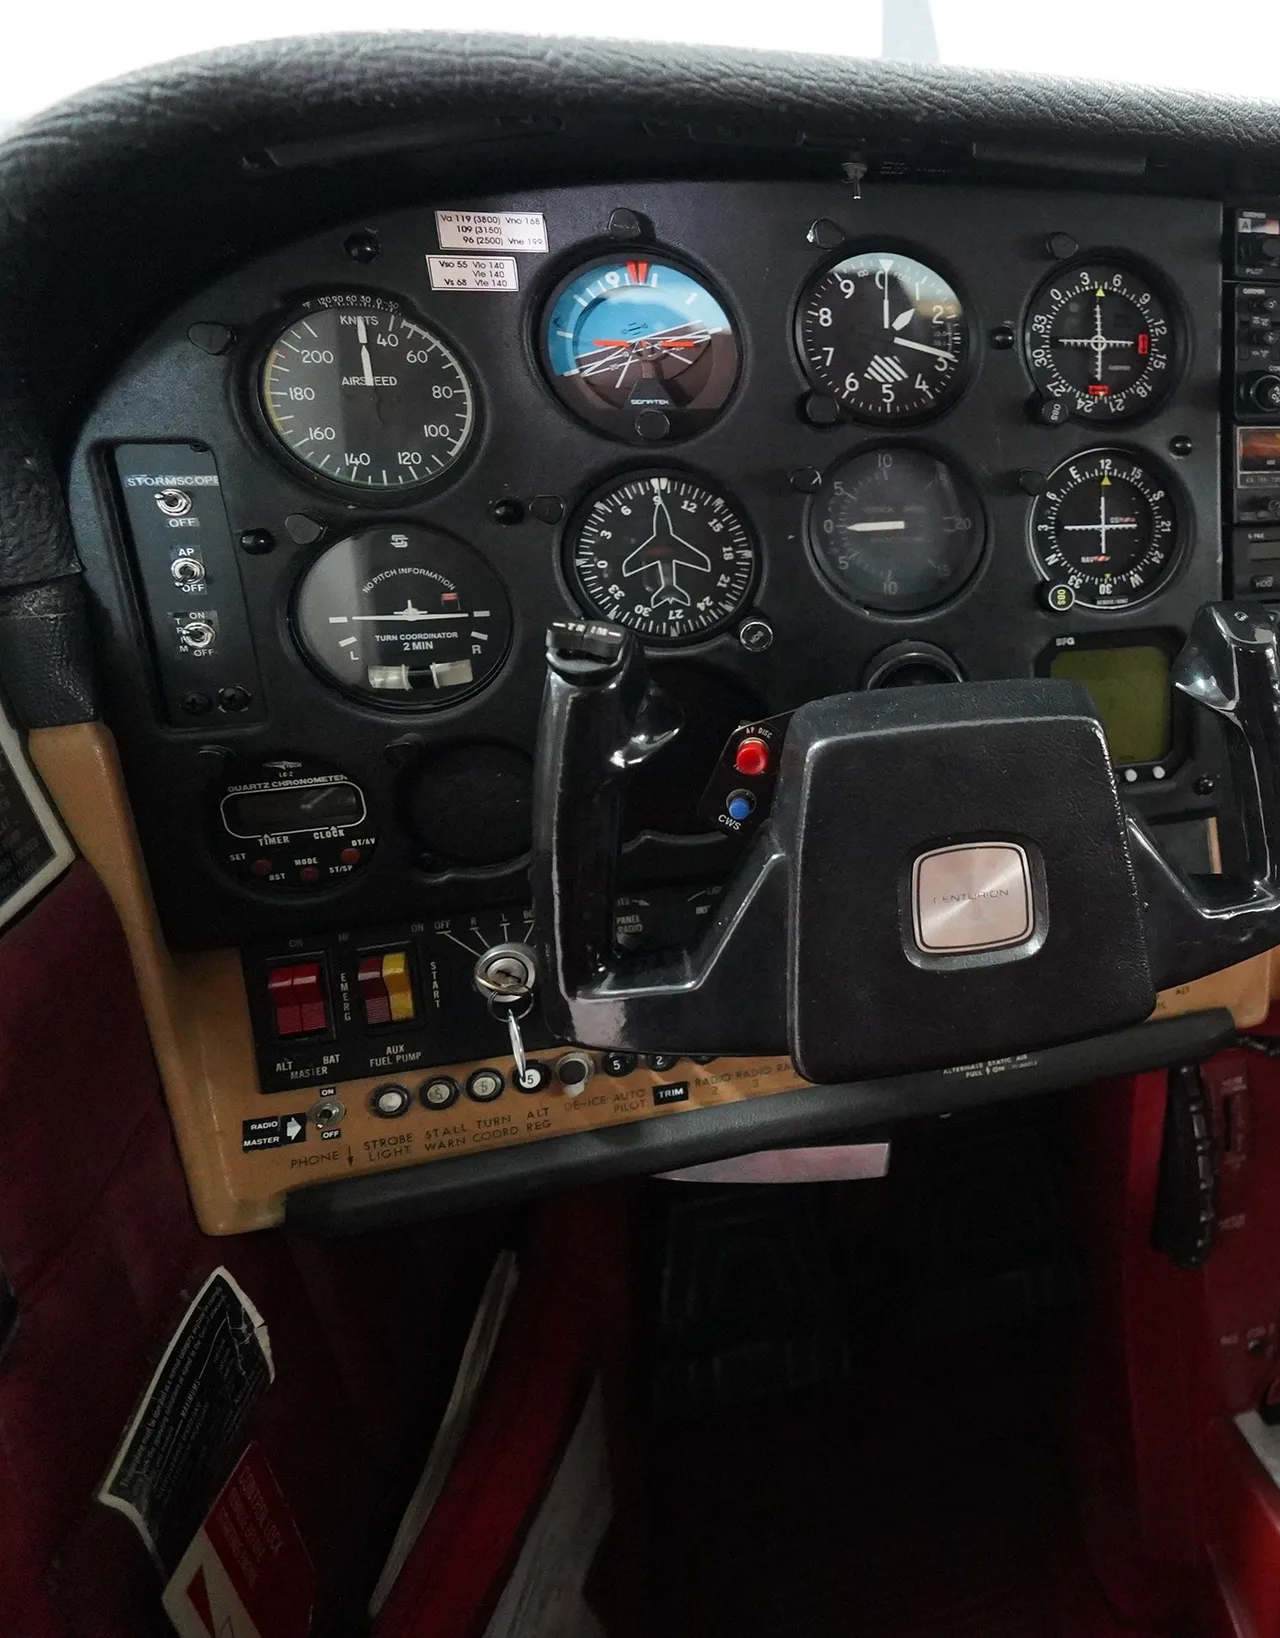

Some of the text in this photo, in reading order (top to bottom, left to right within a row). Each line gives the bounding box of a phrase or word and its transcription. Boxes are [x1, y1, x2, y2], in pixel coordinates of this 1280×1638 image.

[440, 214, 540, 225] Va 119 (3800) Vno 168
[457, 225, 502, 235] 109 (3150)
[463, 236, 543, 246] 96 (2500) Vne 199
[439, 260, 455, 269] Vso
[457, 261, 468, 269] 55
[489, 262, 505, 270] 140
[489, 270, 505, 278] 140
[1080, 272, 1091, 285] 3
[444, 278, 454, 287] Vs
[491, 279, 507, 287] 140
[839, 279, 855, 299] 9
[360, 295, 371, 303] 30
[1050, 288, 1063, 301] 0
[819, 307, 833, 327] 8
[932, 305, 944, 324] 2
[1032, 314, 1048, 334] 33
[1153, 318, 1168, 336] 12
[376, 334, 399, 347] 40
[301, 350, 334, 364] 200
[406, 350, 428, 363] 60
[822, 347, 834, 366] 7
[1032, 348, 1048, 367] 30
[1153, 353, 1168, 370] 15
[341, 376, 398, 386] AIRSEED
[845, 372, 860, 392] 6
[914, 373, 929, 392] 4
[288, 387, 315, 401] 180
[432, 385, 453, 399] 80
[882, 384, 895, 403] 5
[1046, 381, 1067, 397] 27
[1136, 381, 1152, 398] 18
[1050, 403, 1061, 421] OBS
[1076, 399, 1095, 413] 24
[1109, 399, 1125, 413] 21
[308, 426, 336, 441] 160
[423, 424, 450, 438] 100
[344, 452, 371, 466] 140
[398, 451, 422, 465] 120
[1099, 459, 1112, 470] 12
[1068, 466, 1080, 479] E
[1130, 467, 1143, 479] 15
[127, 475, 219, 487] STORMSCOPE
[833, 481, 845, 496] 5
[1046, 491, 1057, 501] 6
[1152, 490, 1165, 501] S
[680, 500, 698, 513] 12
[169, 518, 197, 528] OFF
[707, 518, 724, 533] 15
[823, 519, 834, 533] 0
[1037, 524, 1050, 532] 3
[1160, 520, 1172, 533] 21
[178, 548, 195, 557] AP
[362, 566, 457, 595] NO PITCH INFORMATION
[1255, 579, 1273, 589] HDG
[181, 584, 205, 593] OFF
[1099, 583, 1113, 595] 30
[1057, 589, 1066, 605] OBS
[189, 612, 205, 620] ON
[634, 604, 653, 618] 30
[567, 622, 608, 636] TRIM
[375, 631, 459, 642] TURN COORDINATOR
[194, 648, 215, 657] OFF
[403, 641, 434, 651] 2 MIN
[472, 644, 482, 655] R
[746, 726, 773, 739] AP DISC
[227, 774, 348, 793] QUARTZ CHRONOMETER
[718, 814, 742, 831] CWS
[258, 835, 291, 847] TIMER
[313, 829, 346, 840] CLOCK
[351, 838, 376, 847] DT/AV
[230, 853, 247, 861] SET
[294, 857, 319, 866] MODE
[329, 865, 353, 874] ST/SP
[269, 872, 286, 882] RST
[434, 920, 451, 930] OFF
[430, 961, 441, 1009] START
[340, 972, 352, 1022] EMERG
[386, 1044, 405, 1055] AUX
[275, 1053, 341, 1072] ALT BAT
[369, 1051, 422, 1068] FUEL PUMP
[290, 1066, 328, 1080] MASTER
[736, 1065, 772, 1080] RADIO
[695, 1073, 731, 1088] RADIO
[321, 1088, 335, 1096] ON
[612, 1089, 647, 1102] AUTO
[658, 1087, 685, 1099] TRIM
[613, 1100, 647, 1113] PILOT
[526, 1107, 550, 1120] ALT
[250, 1120, 279, 1132] RADIO
[475, 1115, 512, 1129] TURN
[526, 1119, 552, 1132] REG
[322, 1130, 340, 1139] OFF
[425, 1123, 467, 1140] STALL
[472, 1126, 519, 1143] COORD
[243, 1135, 280, 1147] MASTER
[363, 1132, 413, 1151] STROBE
[424, 1138, 466, 1152] WARN
[291, 1150, 340, 1169] PHONE
[368, 1145, 413, 1162] LIGHT
[181, 1380, 201, 1418] MAXIMUMS
